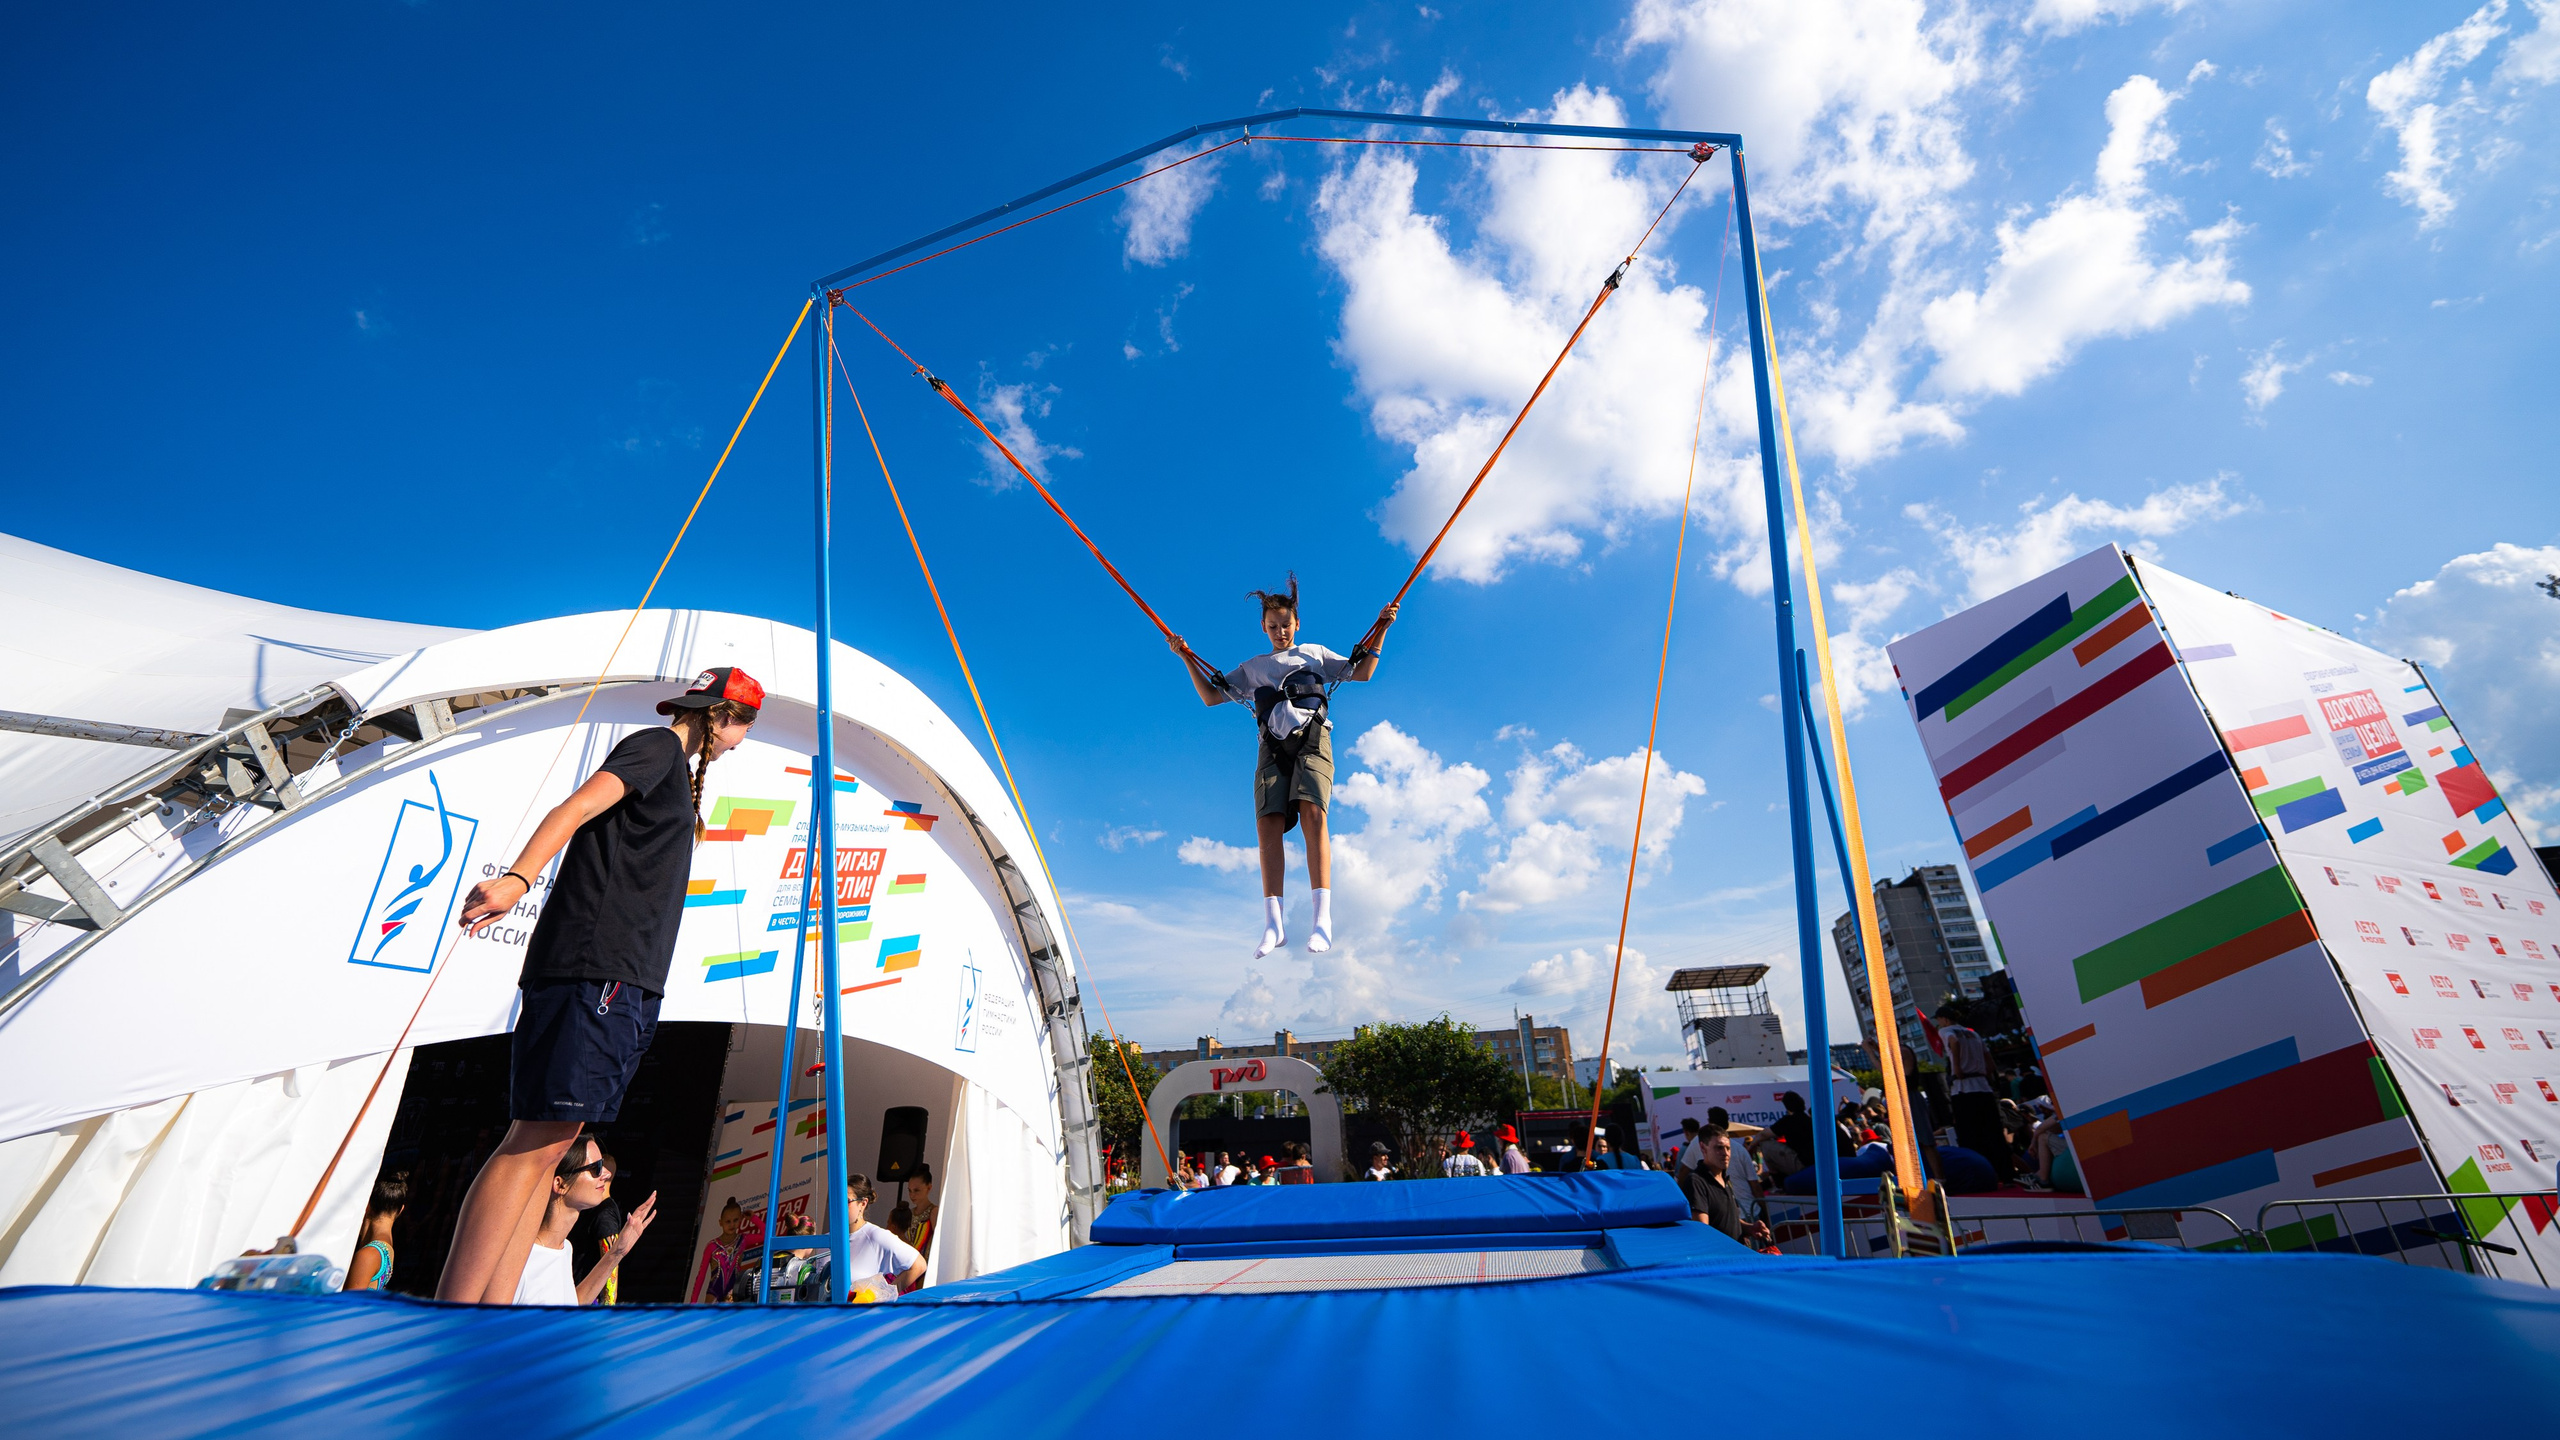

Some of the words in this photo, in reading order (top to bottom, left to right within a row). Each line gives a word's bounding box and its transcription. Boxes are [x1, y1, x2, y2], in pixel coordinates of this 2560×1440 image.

[2323, 693, 2382, 729] ДОСТИГАЯ
[2354, 718, 2398, 754] ЦЕЛИ!
[771, 918, 777, 927] В
[778, 915, 797, 926] ЧЕСТЬ
[2355, 920, 2381, 935] ЛЕТО
[2429, 974, 2453, 989] ЛЕТО
[2478, 1144, 2505, 1161] ЛЕТО
